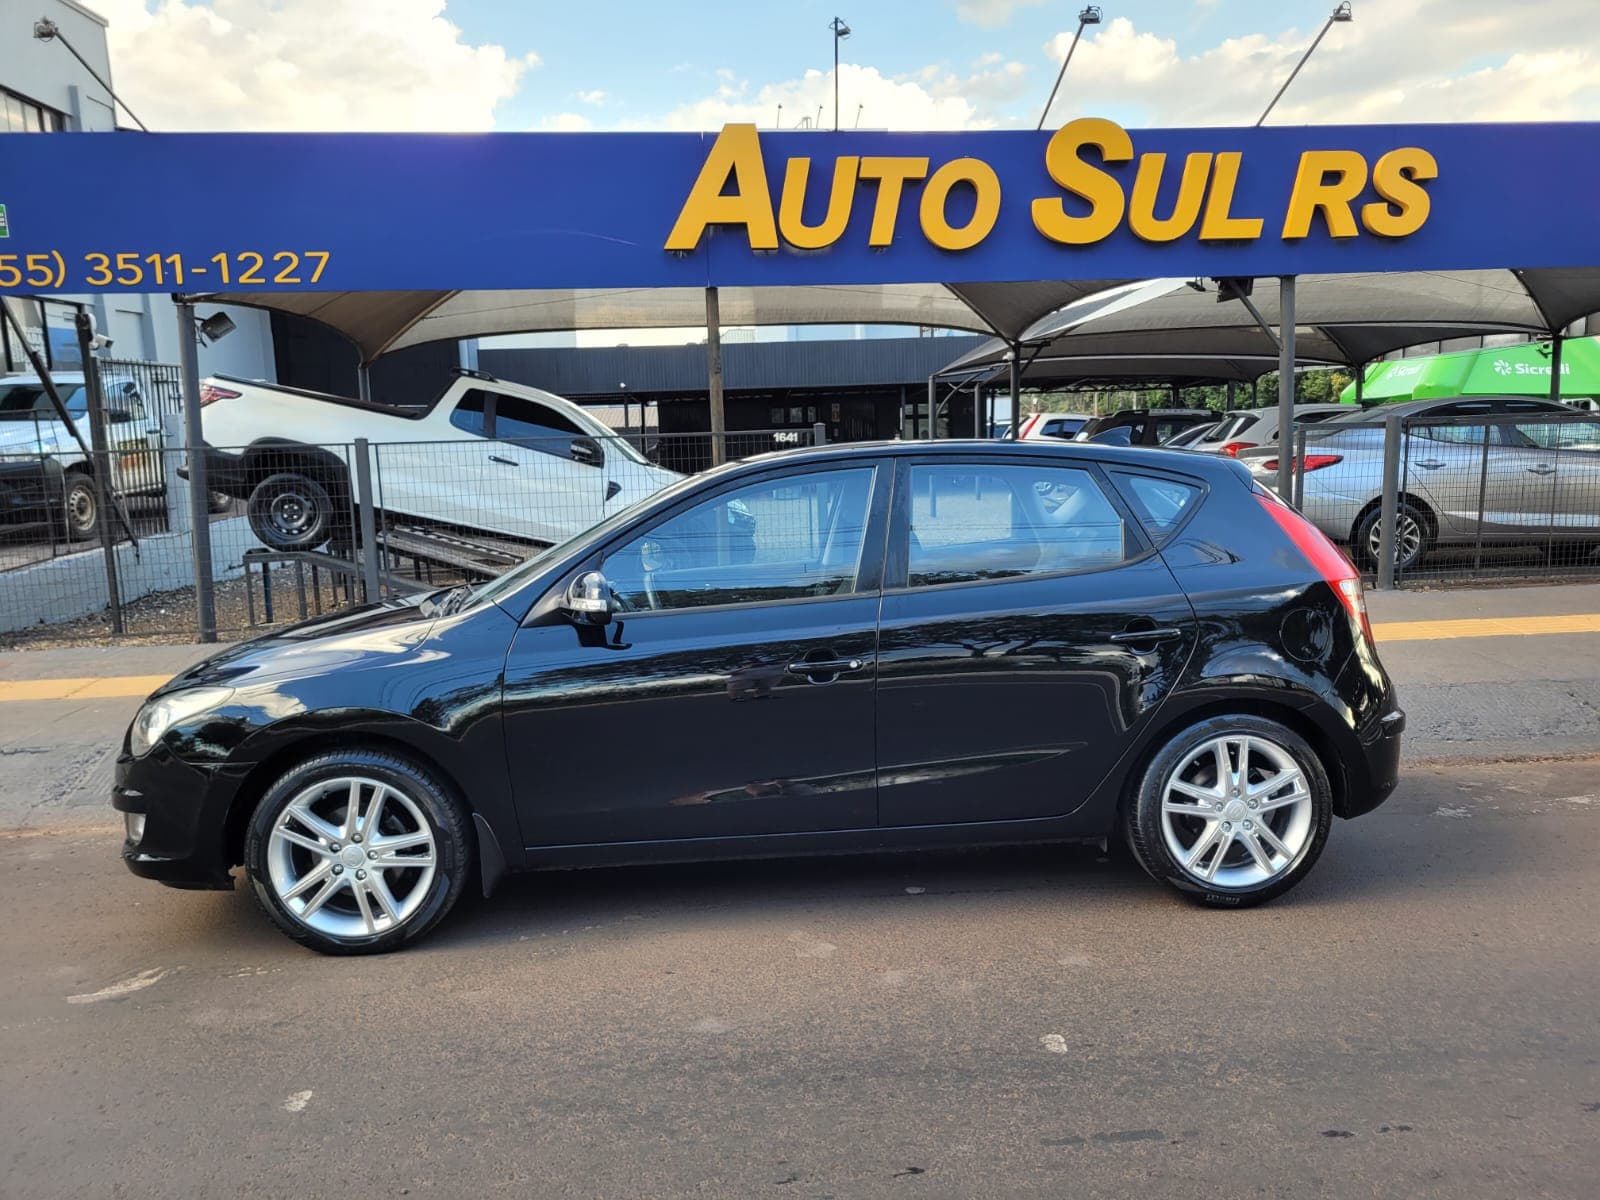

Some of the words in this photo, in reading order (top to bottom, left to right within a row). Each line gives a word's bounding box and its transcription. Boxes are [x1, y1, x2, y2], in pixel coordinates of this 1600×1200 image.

[1281, 147, 1438, 240] RS
[84, 251, 330, 286] 3511-1227
[773, 432, 798, 442] 1641
